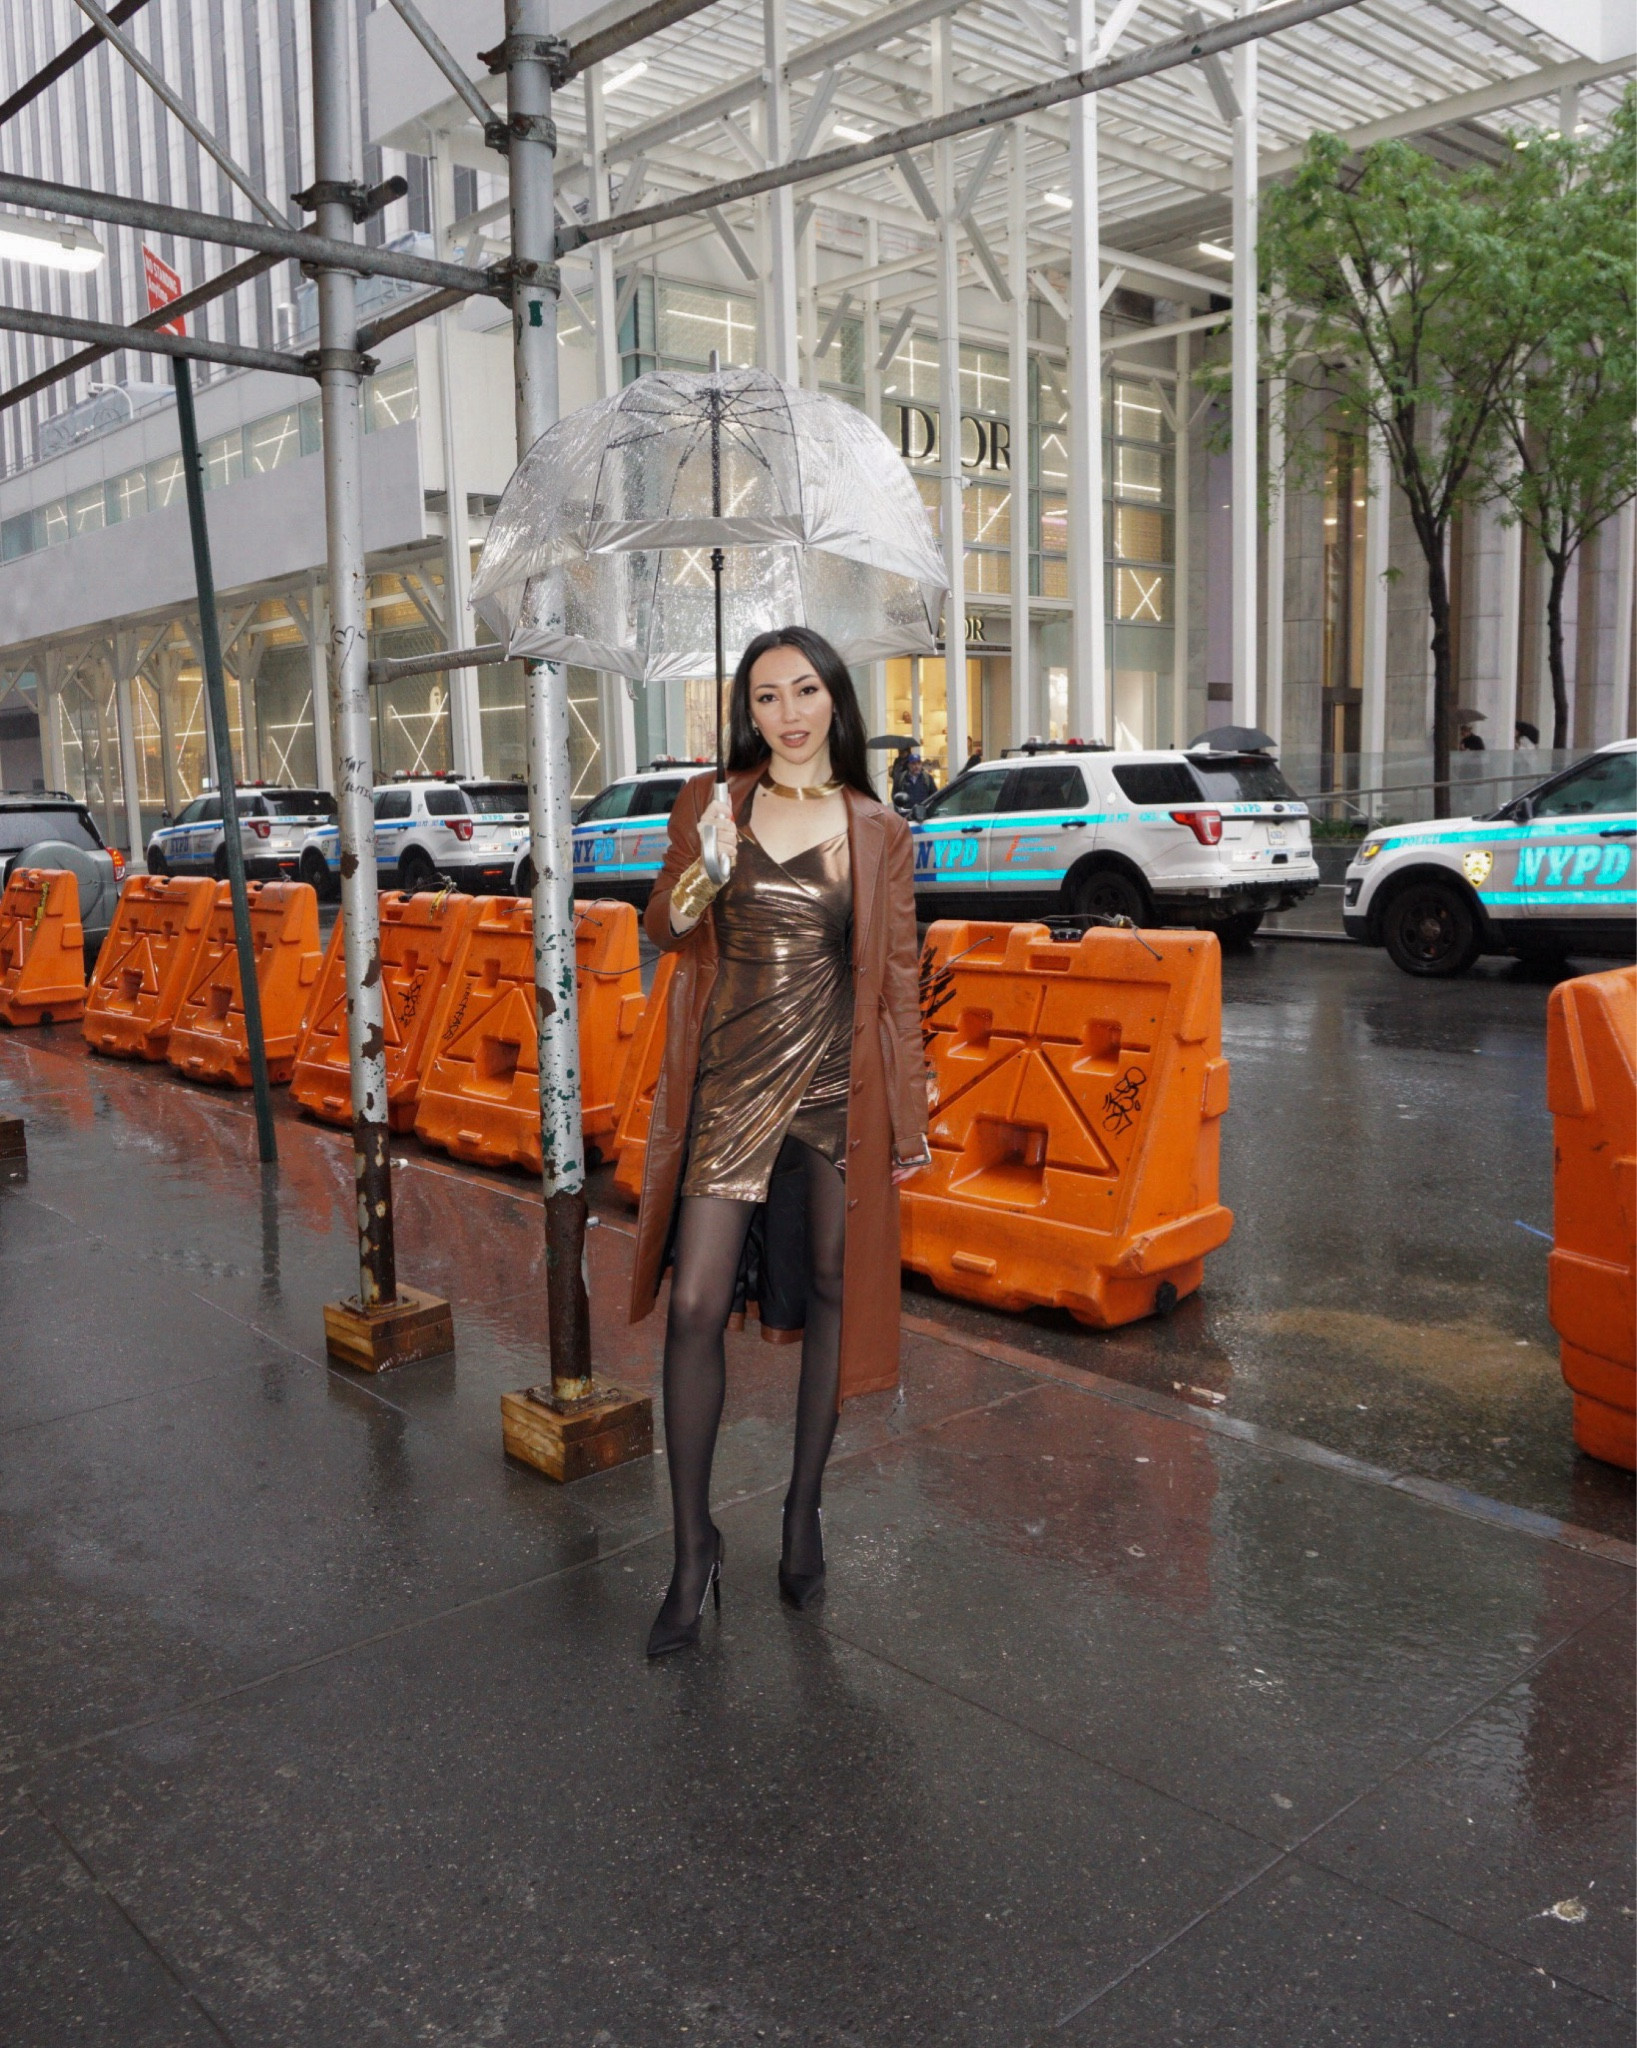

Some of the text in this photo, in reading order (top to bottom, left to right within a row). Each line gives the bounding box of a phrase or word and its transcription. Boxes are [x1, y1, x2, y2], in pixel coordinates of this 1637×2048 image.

[896, 404, 1011, 471] DOR
[915, 837, 980, 870] NYPD
[1512, 843, 1632, 888] NYPD
